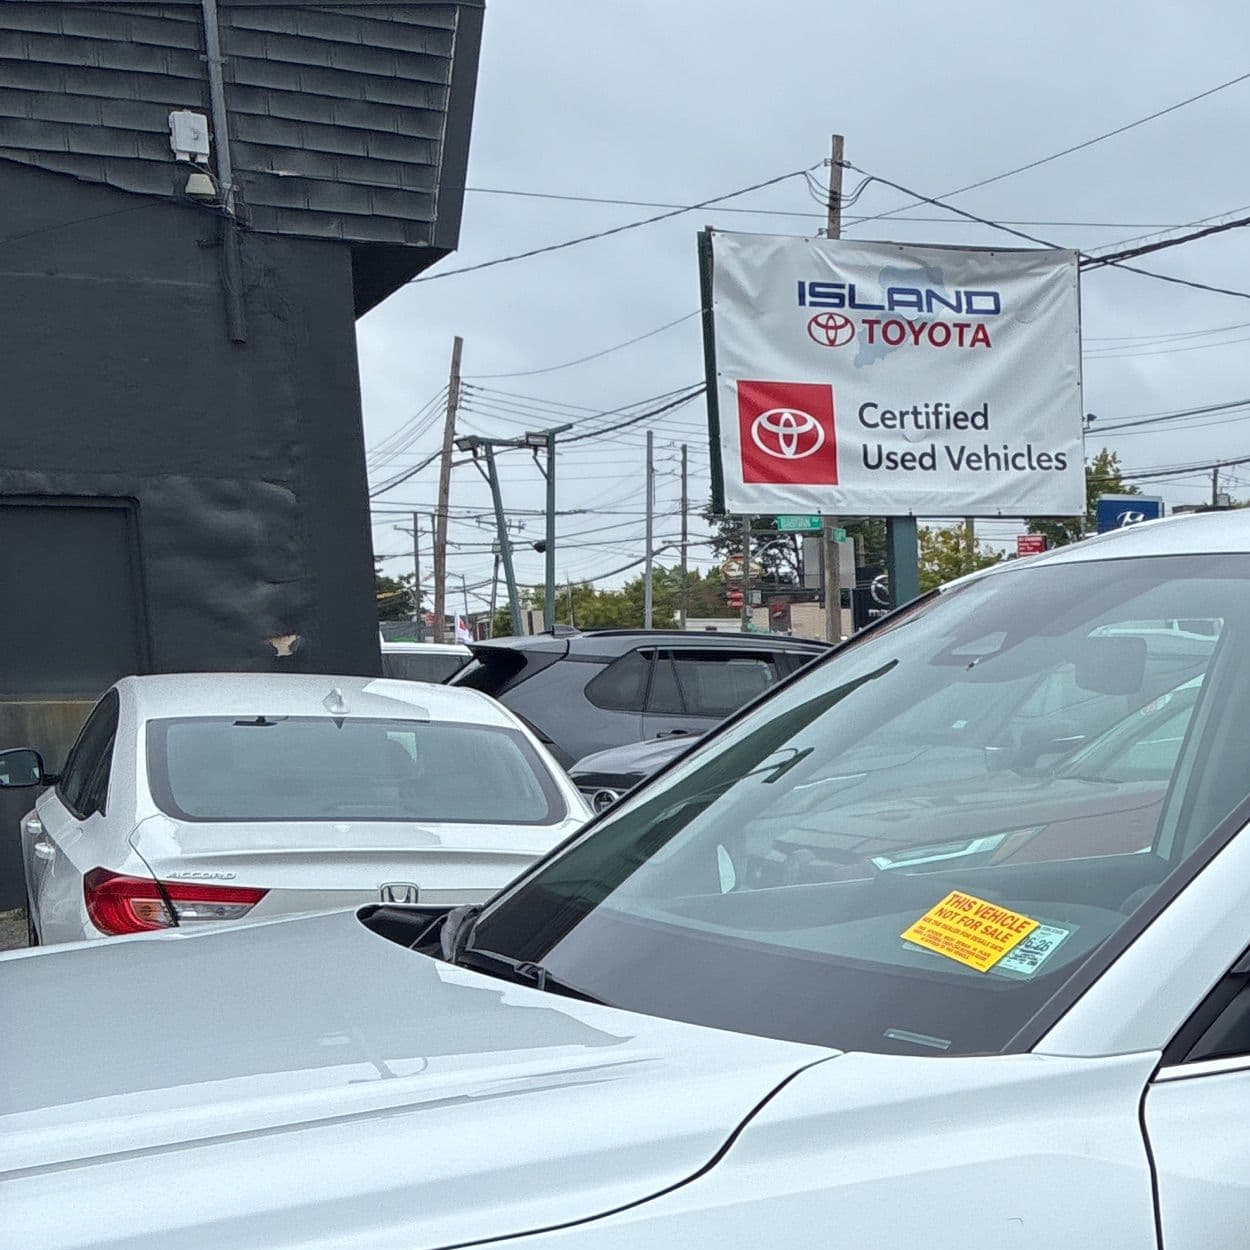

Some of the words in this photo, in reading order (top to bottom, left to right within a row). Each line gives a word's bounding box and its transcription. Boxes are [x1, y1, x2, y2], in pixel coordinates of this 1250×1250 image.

[797, 280, 1000, 315] ISLAND
[861, 318, 992, 348] TOYOTA
[858, 402, 989, 431] Certified
[862, 444, 937, 471] Used
[944, 445, 1068, 472] Vehicles
[934, 907, 960, 921] NOT
[956, 916, 983, 931] FOR
[980, 925, 1013, 944] SALE
[945, 894, 977, 912] THIS
[973, 904, 1031, 934] VEHICLE
